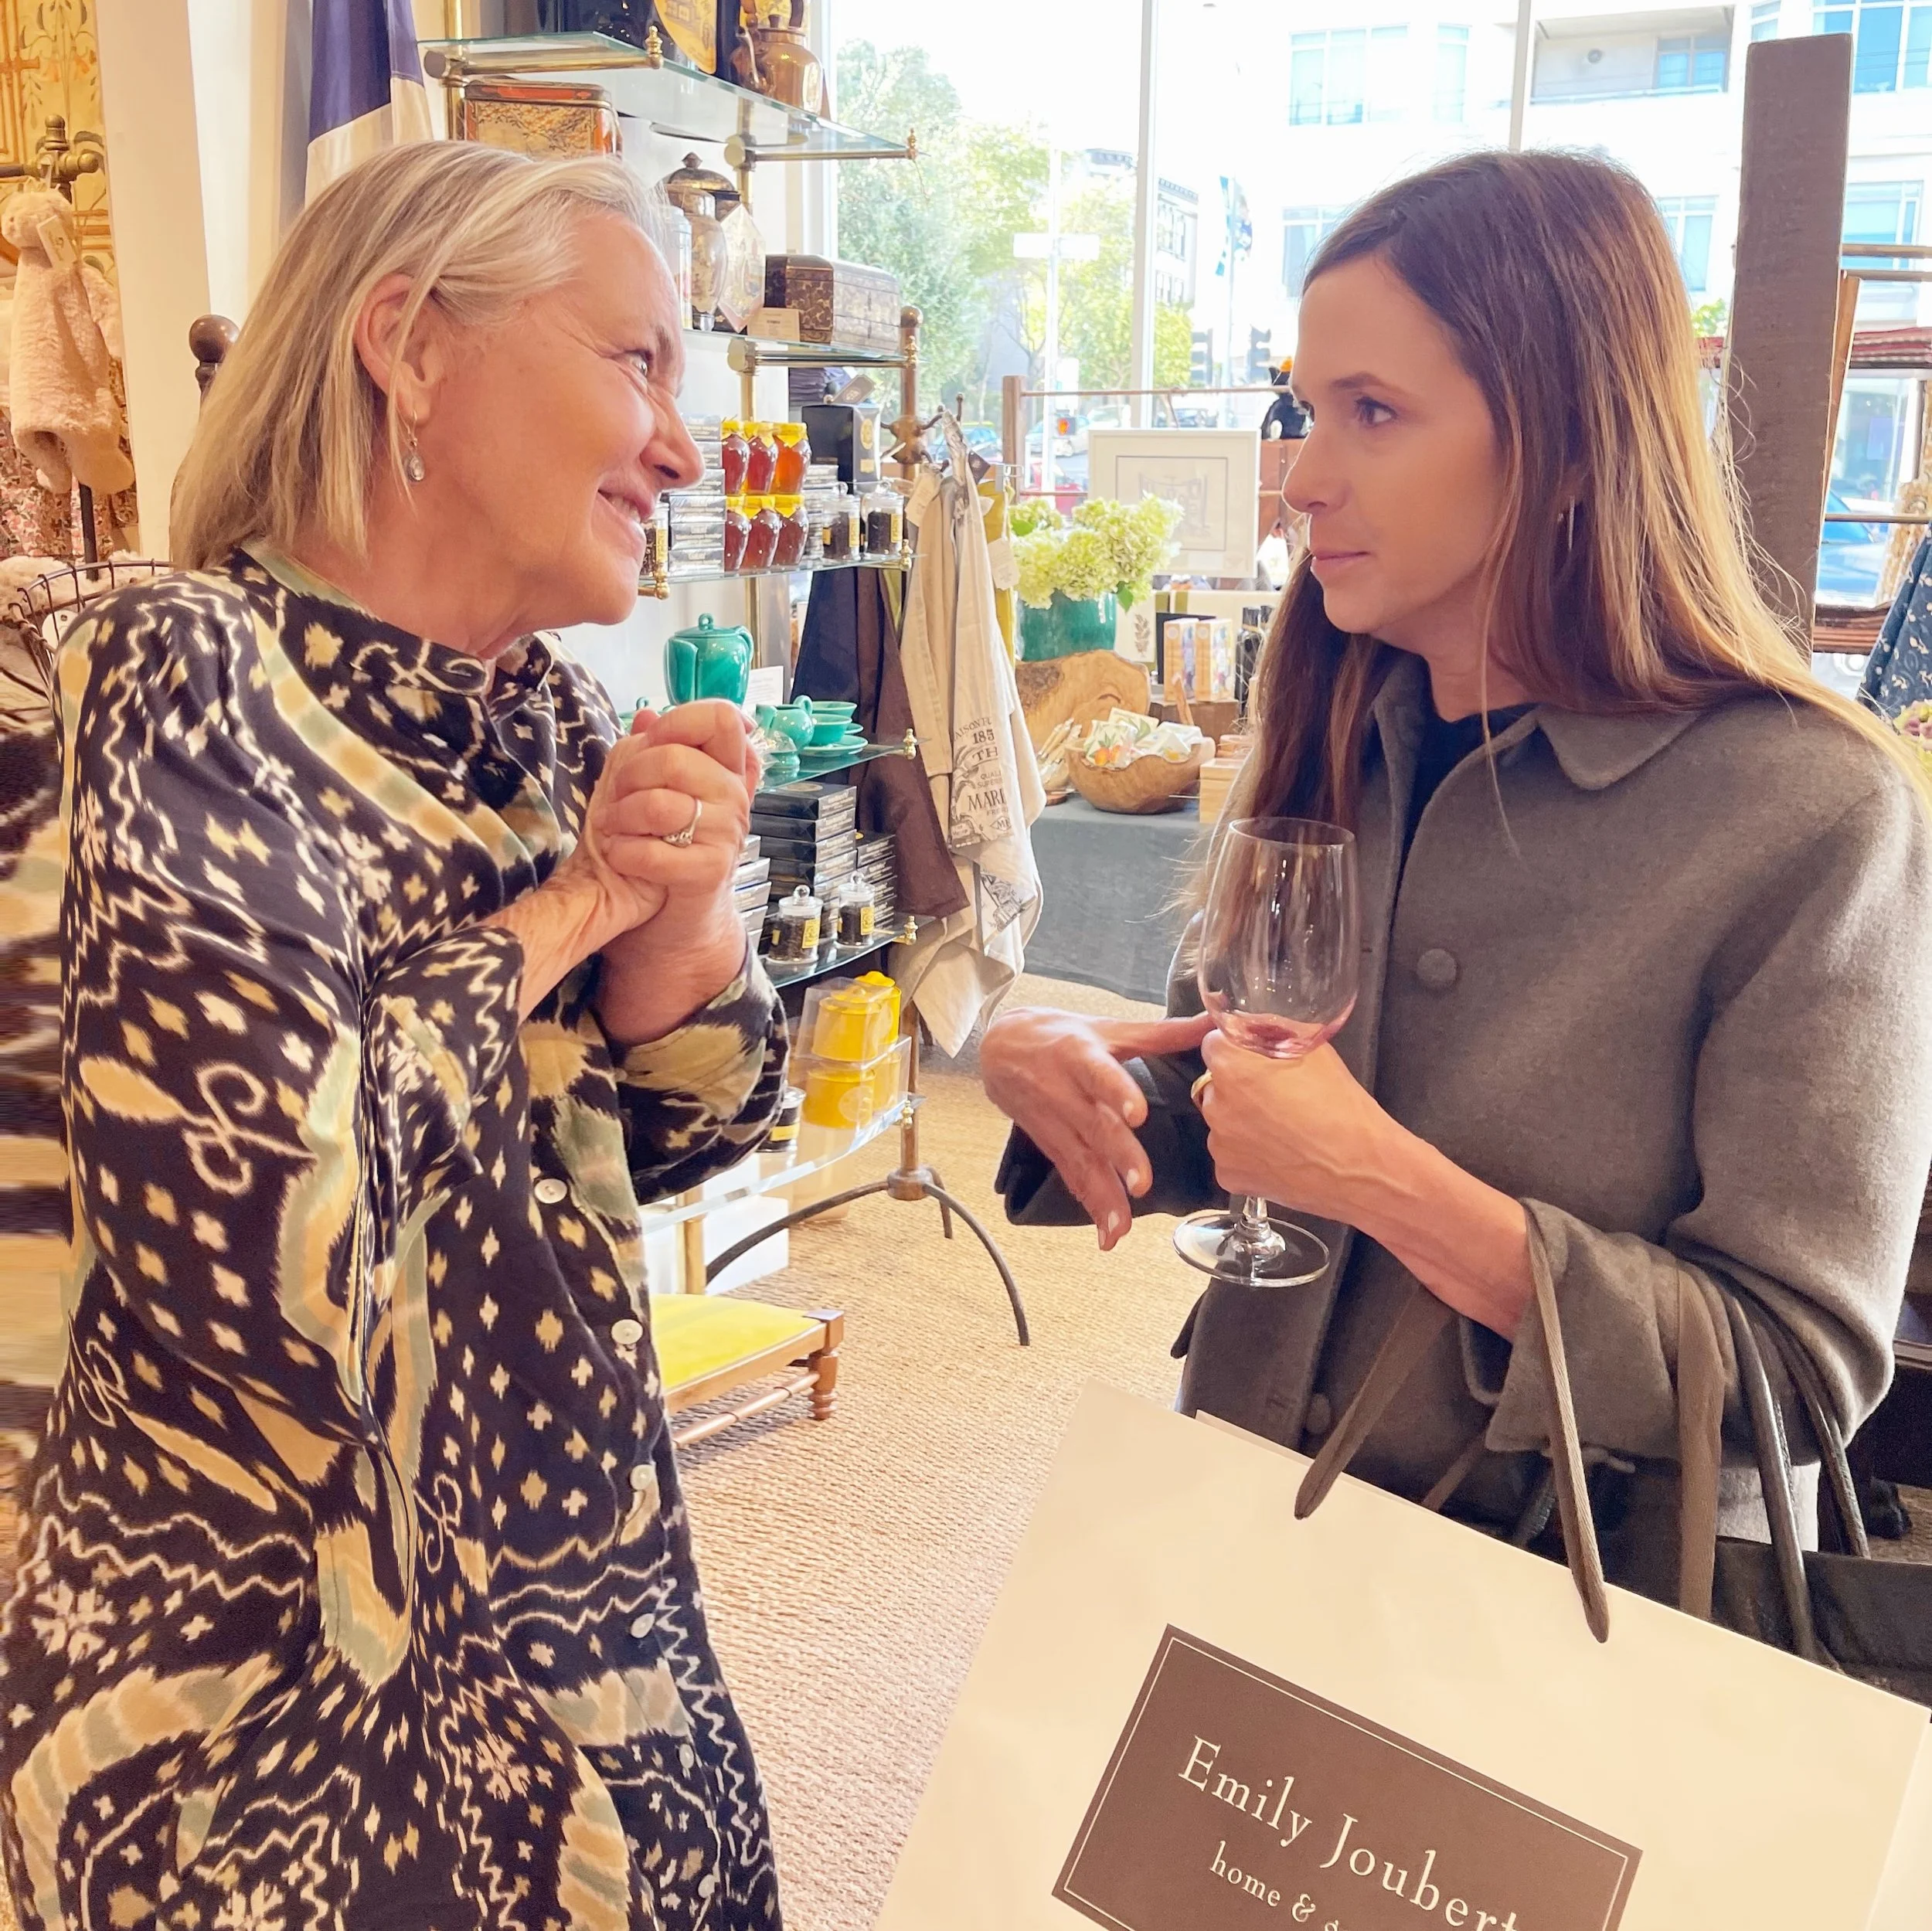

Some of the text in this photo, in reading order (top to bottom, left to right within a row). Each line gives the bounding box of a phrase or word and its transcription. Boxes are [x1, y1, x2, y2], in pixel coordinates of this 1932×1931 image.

[1178, 1735, 1312, 1848] Emily
[1209, 1841, 1316, 1923] home &
